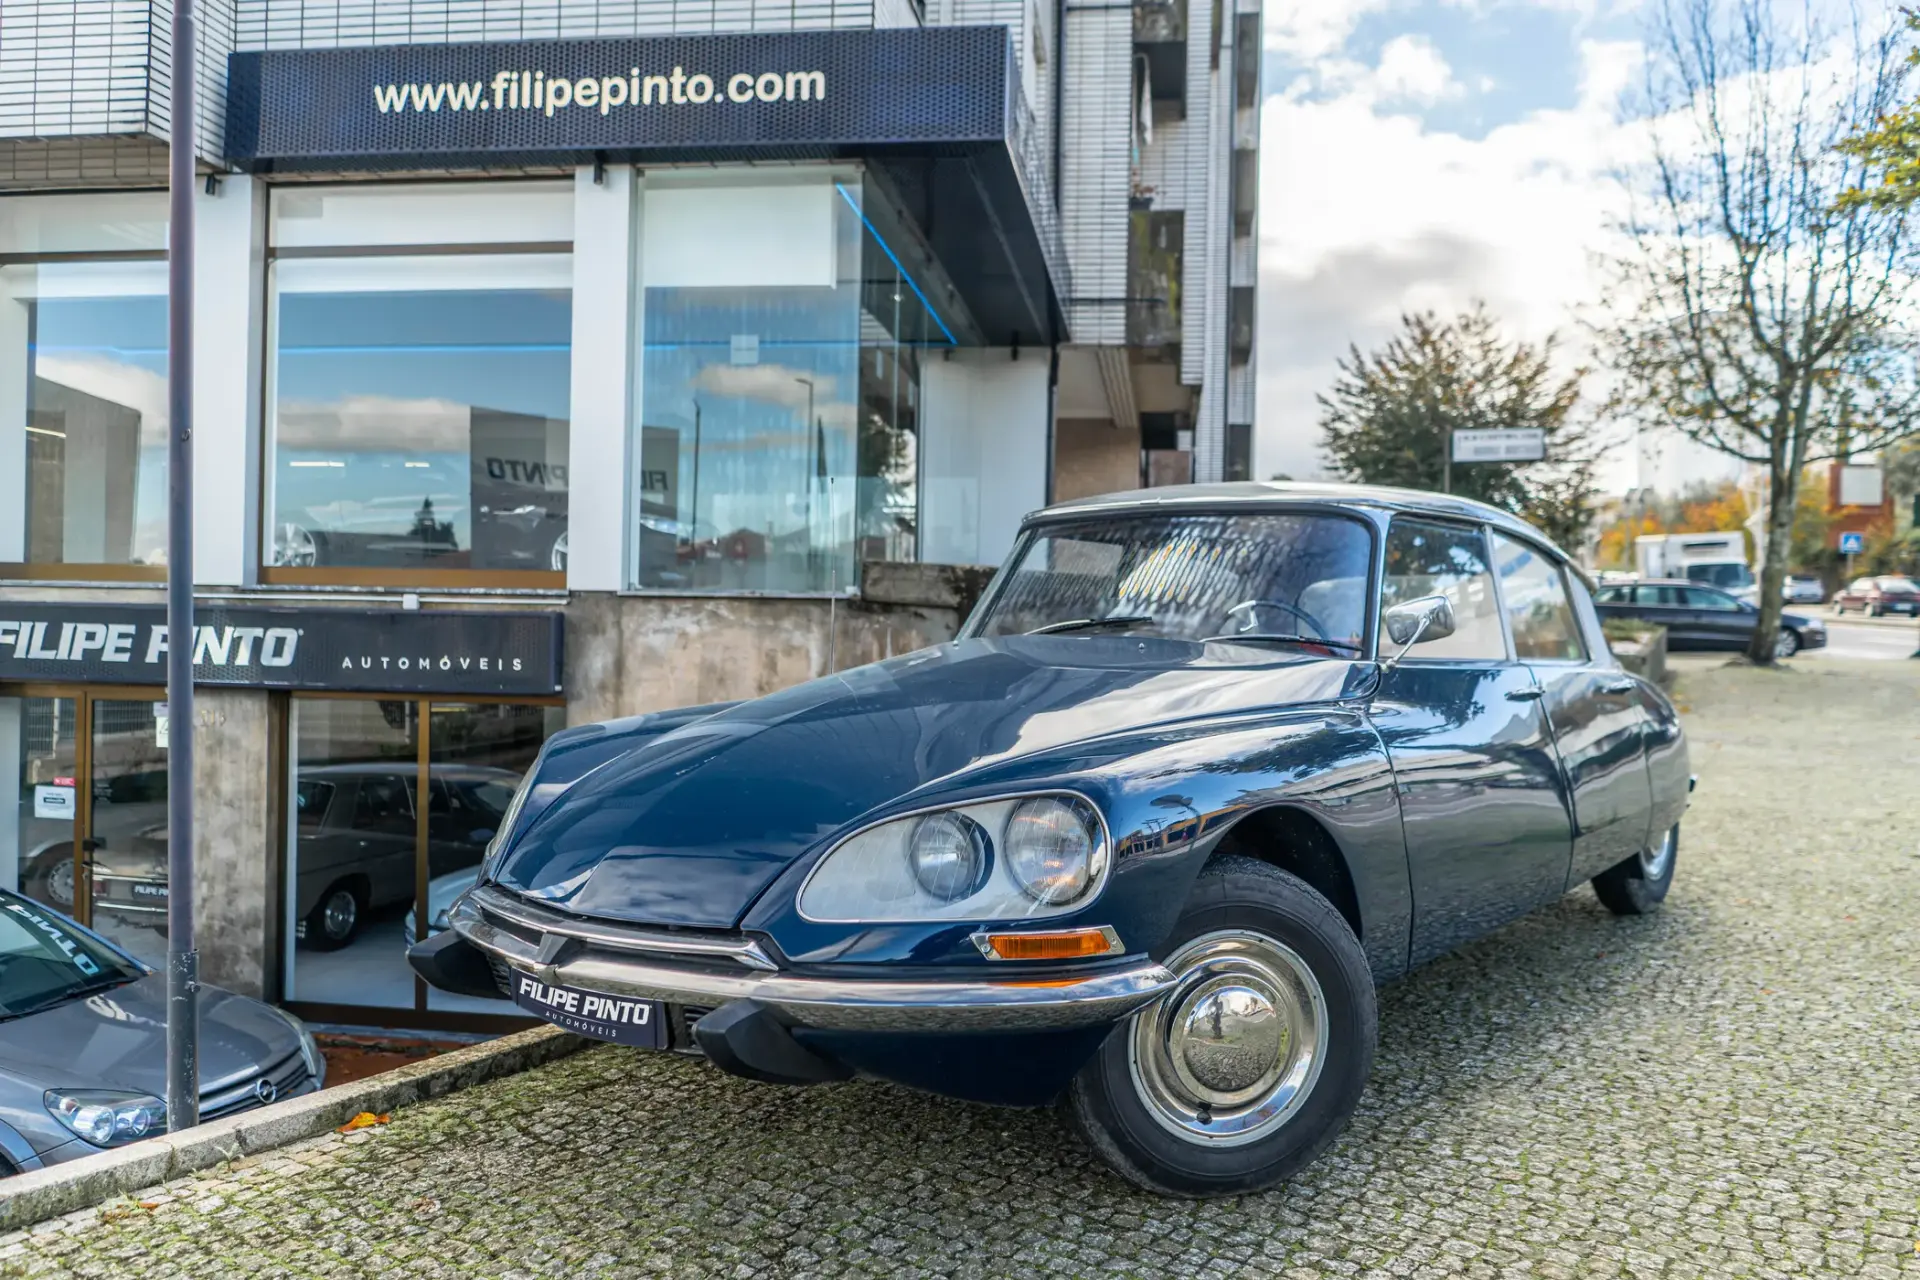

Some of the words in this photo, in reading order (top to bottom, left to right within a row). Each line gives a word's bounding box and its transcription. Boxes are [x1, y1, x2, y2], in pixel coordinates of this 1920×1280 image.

[374, 66, 826, 118] www.filipepinto.com
[145, 625, 299, 667] PNTO
[342, 655, 522, 671] AUTOMÓVEIS
[520, 977, 579, 1013] FILIPE
[582, 995, 651, 1025] PINTO
[545, 1011, 617, 1037] AUTOMÓVEIS
